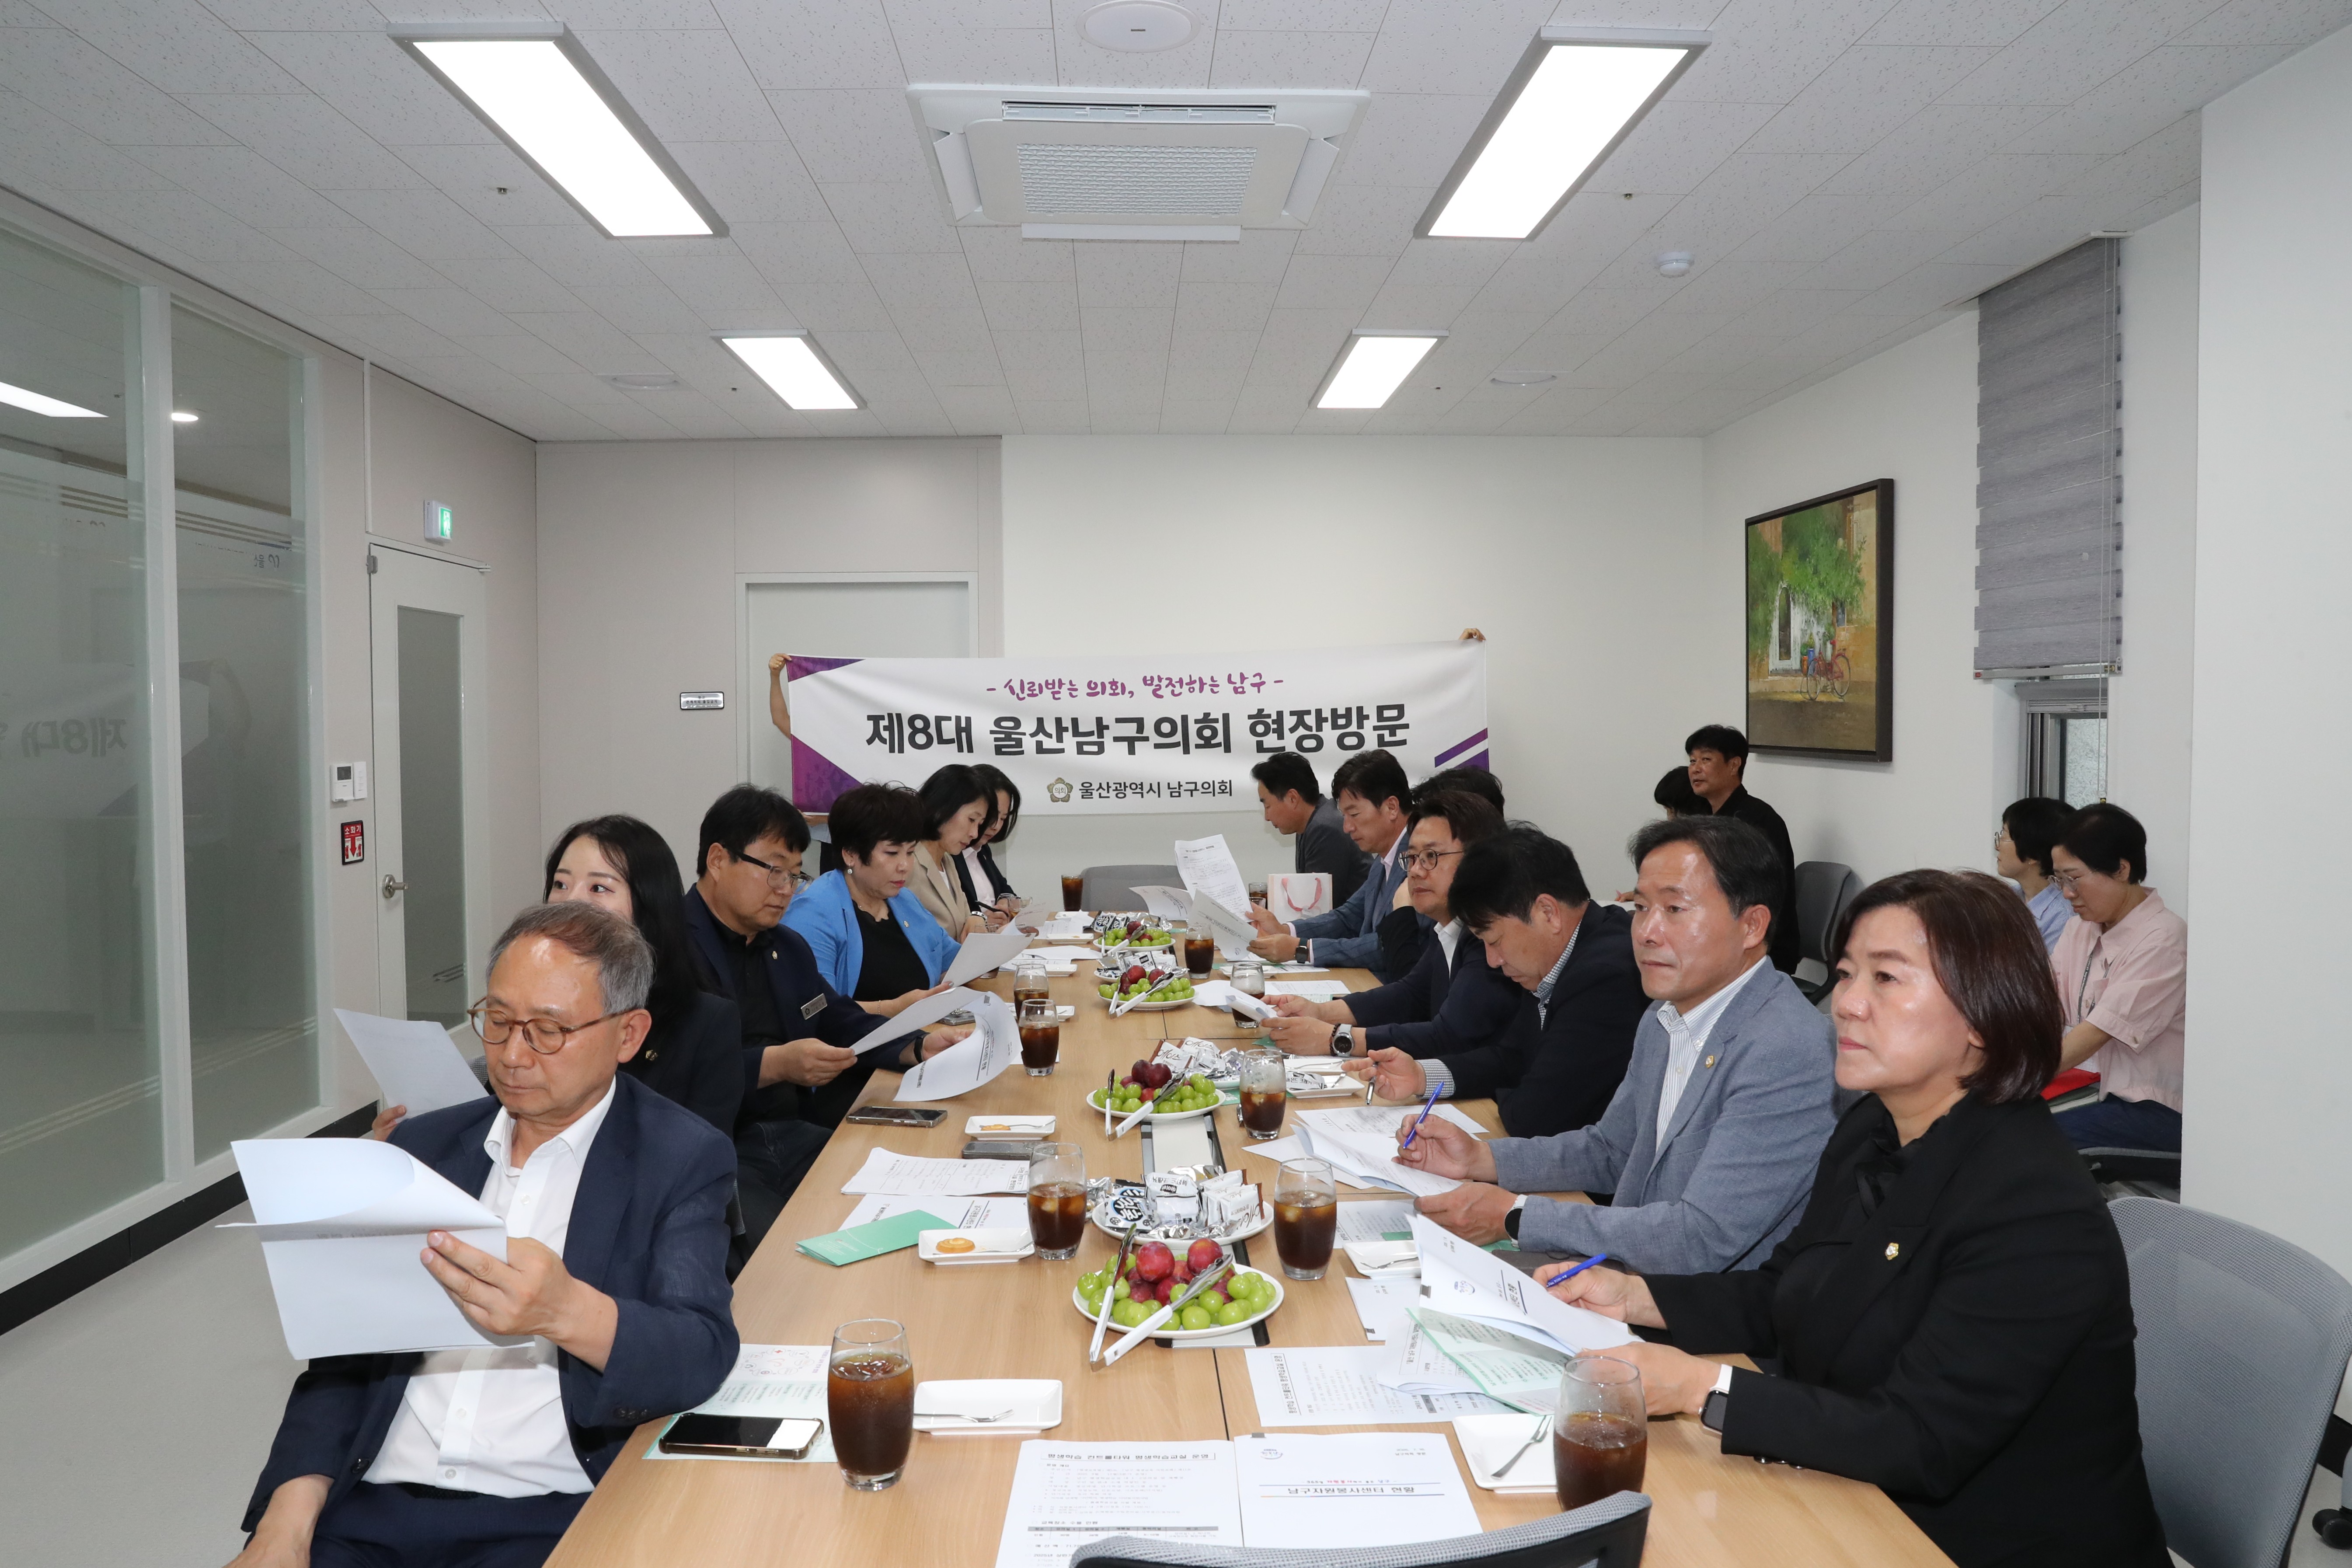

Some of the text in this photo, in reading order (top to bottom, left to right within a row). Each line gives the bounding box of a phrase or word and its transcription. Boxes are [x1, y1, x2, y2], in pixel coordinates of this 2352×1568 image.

[1004, 678, 1078, 700] 신뢰받는
[1086, 678, 1134, 699] 의회,
[1142, 674, 1220, 699] 발전하는
[1227, 672, 1266, 694] 남구
[866, 704, 1410, 756] 제8대 울산남구의회 현장방문
[1079, 780, 1233, 799] 울산광역시 남구의회
[345, 825, 361, 835] 소화기
[1185, 1040, 1213, 1050] 에이스
[1157, 1049, 1182, 1060] 에이스
[1275, 1363, 1288, 1382] 평생학습교실
[1286, 1401, 1297, 1414] 평생학습
